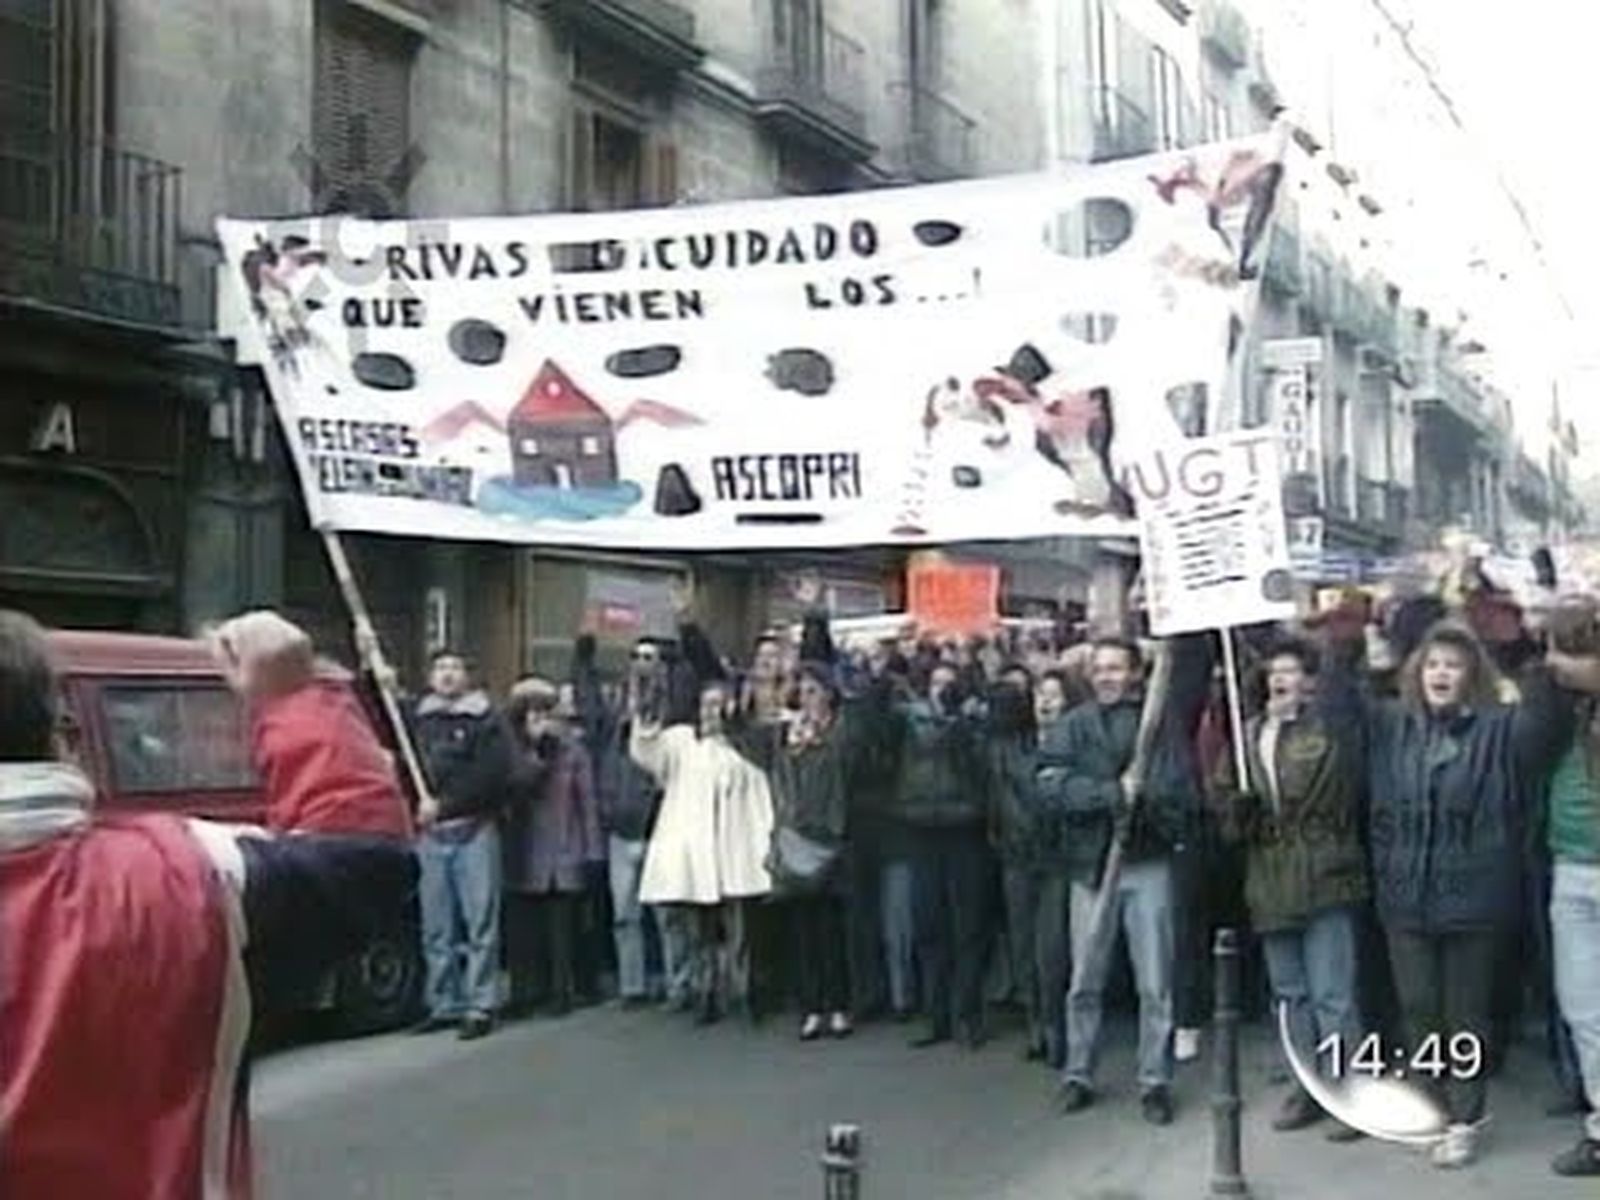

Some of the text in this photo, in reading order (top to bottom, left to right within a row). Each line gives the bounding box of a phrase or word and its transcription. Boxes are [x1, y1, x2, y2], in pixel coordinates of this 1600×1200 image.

[385, 237, 528, 281] RIVAS
[342, 297, 424, 328] QUE
[519, 286, 705, 324] VIENEN
[711, 453, 863, 502] ASCOPRI
[1132, 436, 1271, 501] UGT
